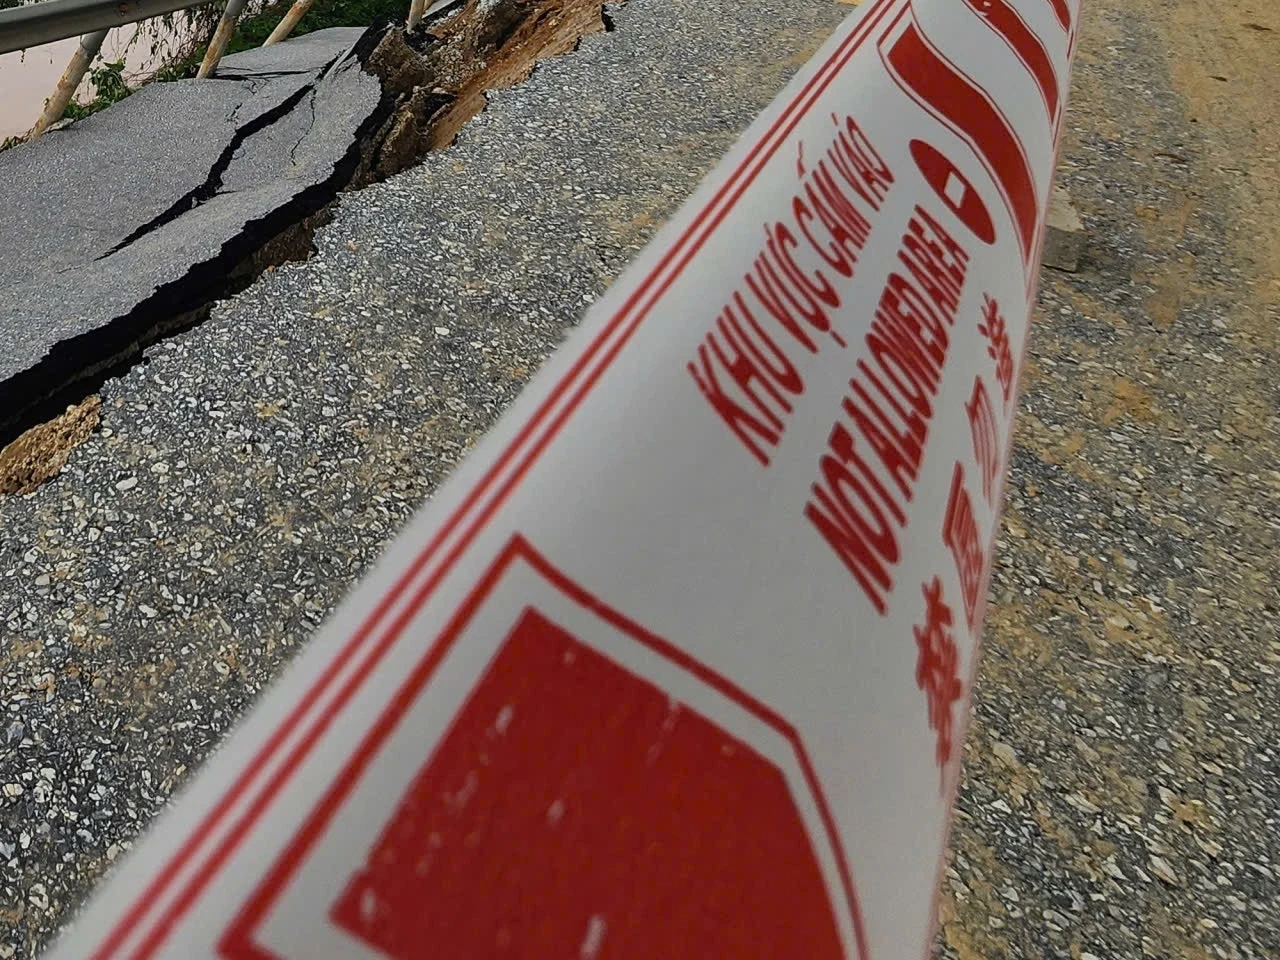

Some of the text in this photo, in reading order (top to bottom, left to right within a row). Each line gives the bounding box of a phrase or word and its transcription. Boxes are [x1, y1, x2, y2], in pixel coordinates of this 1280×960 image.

[792, 140, 871, 278] CẤM
[743, 222, 847, 355] VỰC
[687, 291, 804, 467] KHU
[804, 205, 969, 616] NOT ALLOWED AREA
